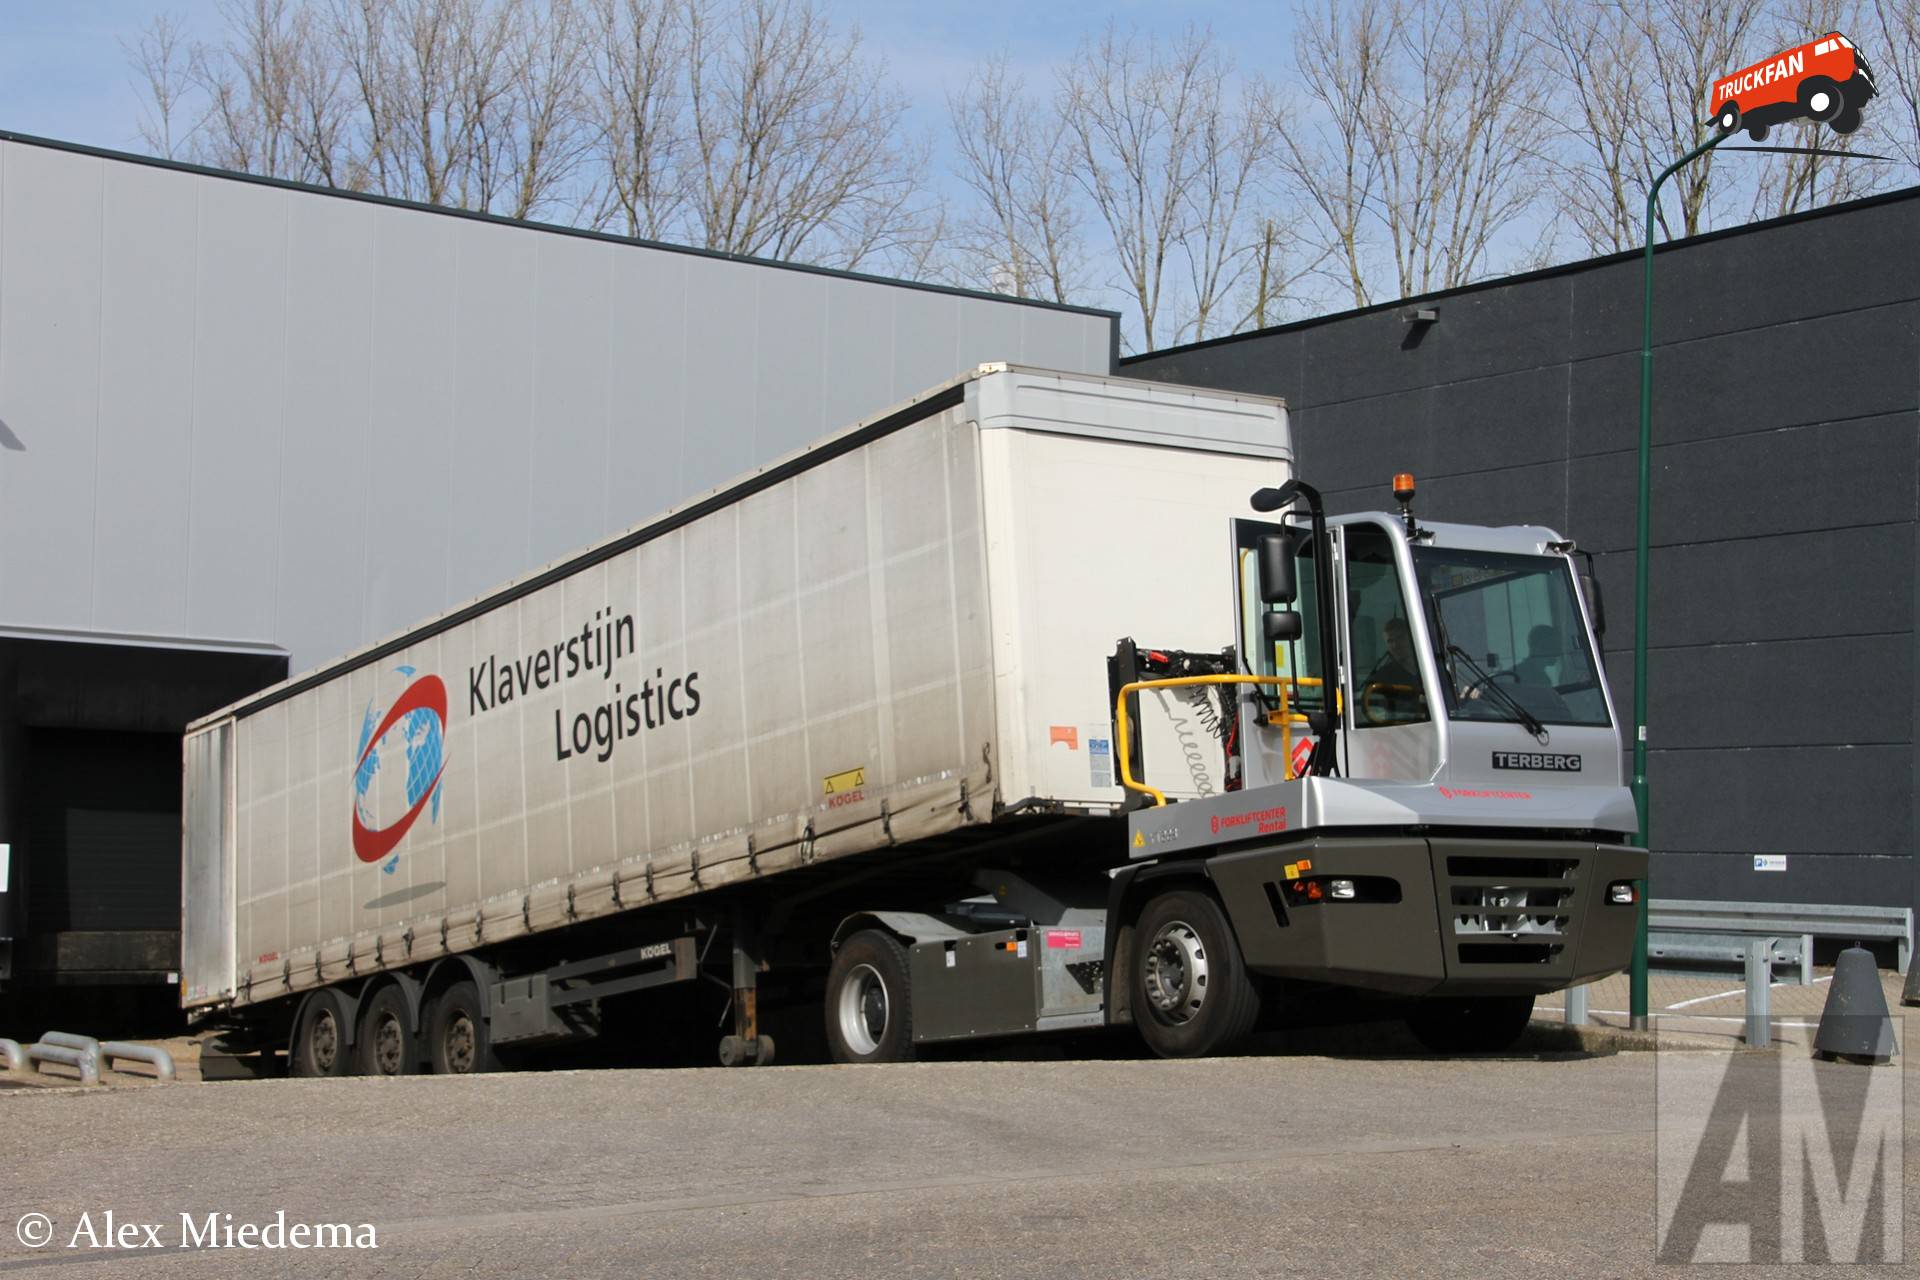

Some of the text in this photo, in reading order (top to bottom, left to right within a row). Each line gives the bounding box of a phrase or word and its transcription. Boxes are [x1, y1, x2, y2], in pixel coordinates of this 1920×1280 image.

[469, 606, 635, 717] Klaverstijn
[555, 667, 701, 763] Logistics
[1494, 753, 1581, 770] TERBERG
[1221, 807, 1287, 829] FORKLIFTCENTER
[1258, 818, 1287, 833] Rental
